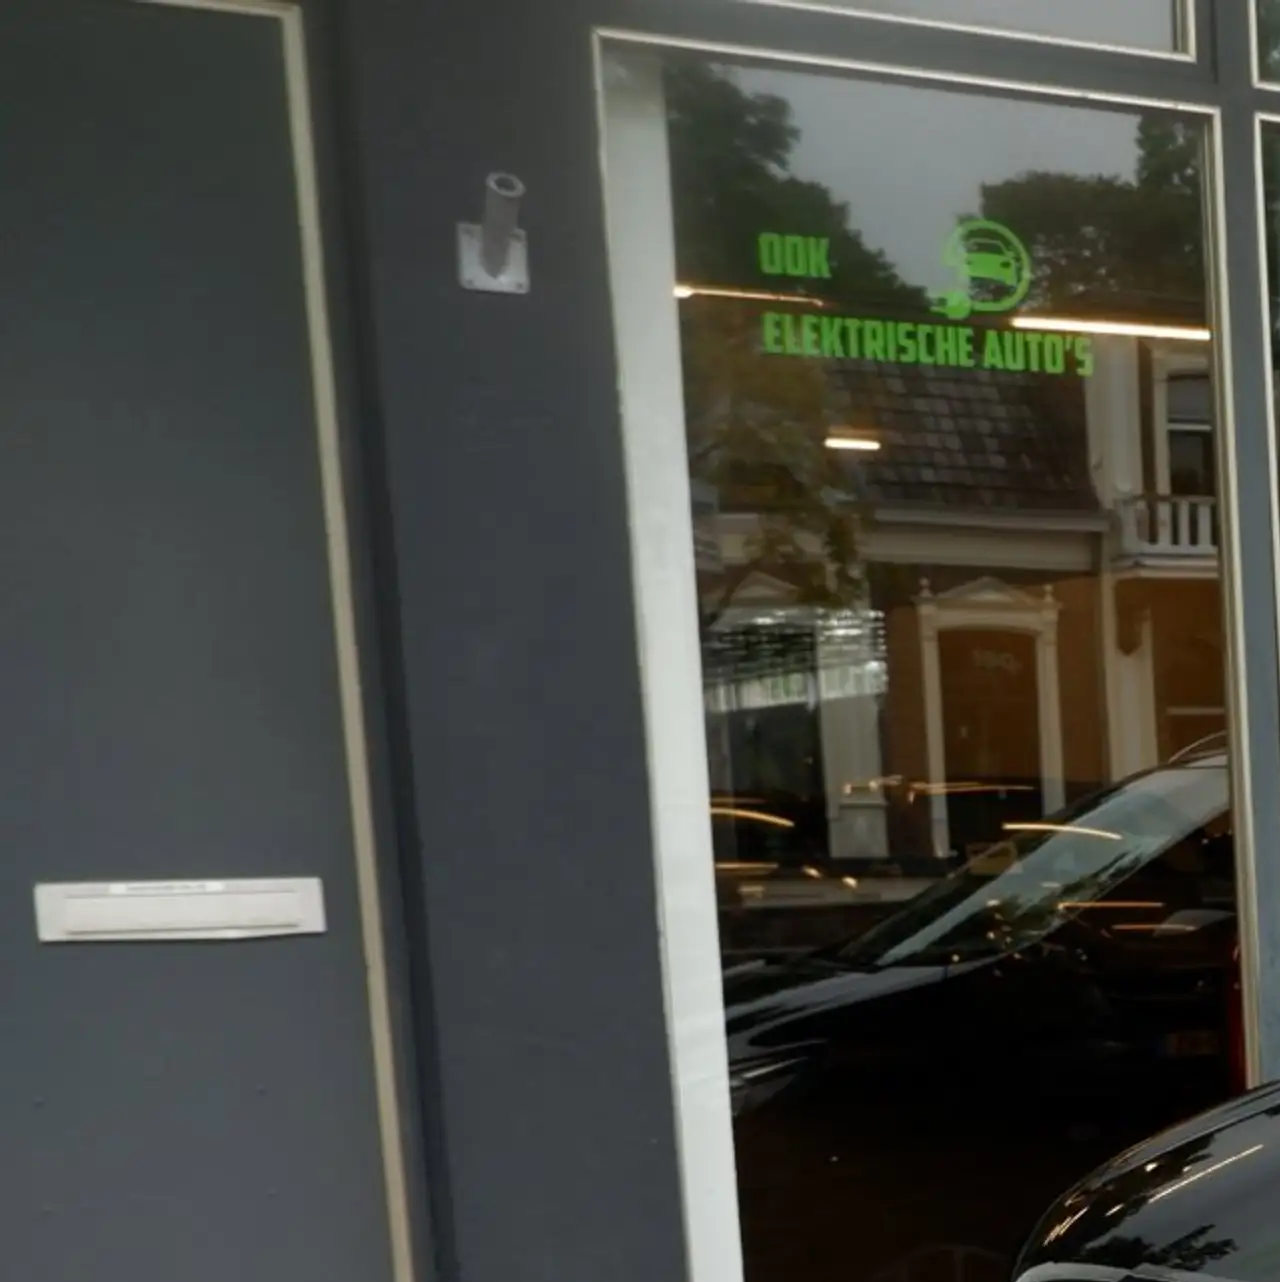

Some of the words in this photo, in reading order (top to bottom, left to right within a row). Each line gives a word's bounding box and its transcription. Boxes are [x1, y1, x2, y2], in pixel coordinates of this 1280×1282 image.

[758, 232, 830, 279] OOK
[762, 312, 975, 367] ELEKTRISCHE
[983, 330, 1093, 377] AUTO'S
